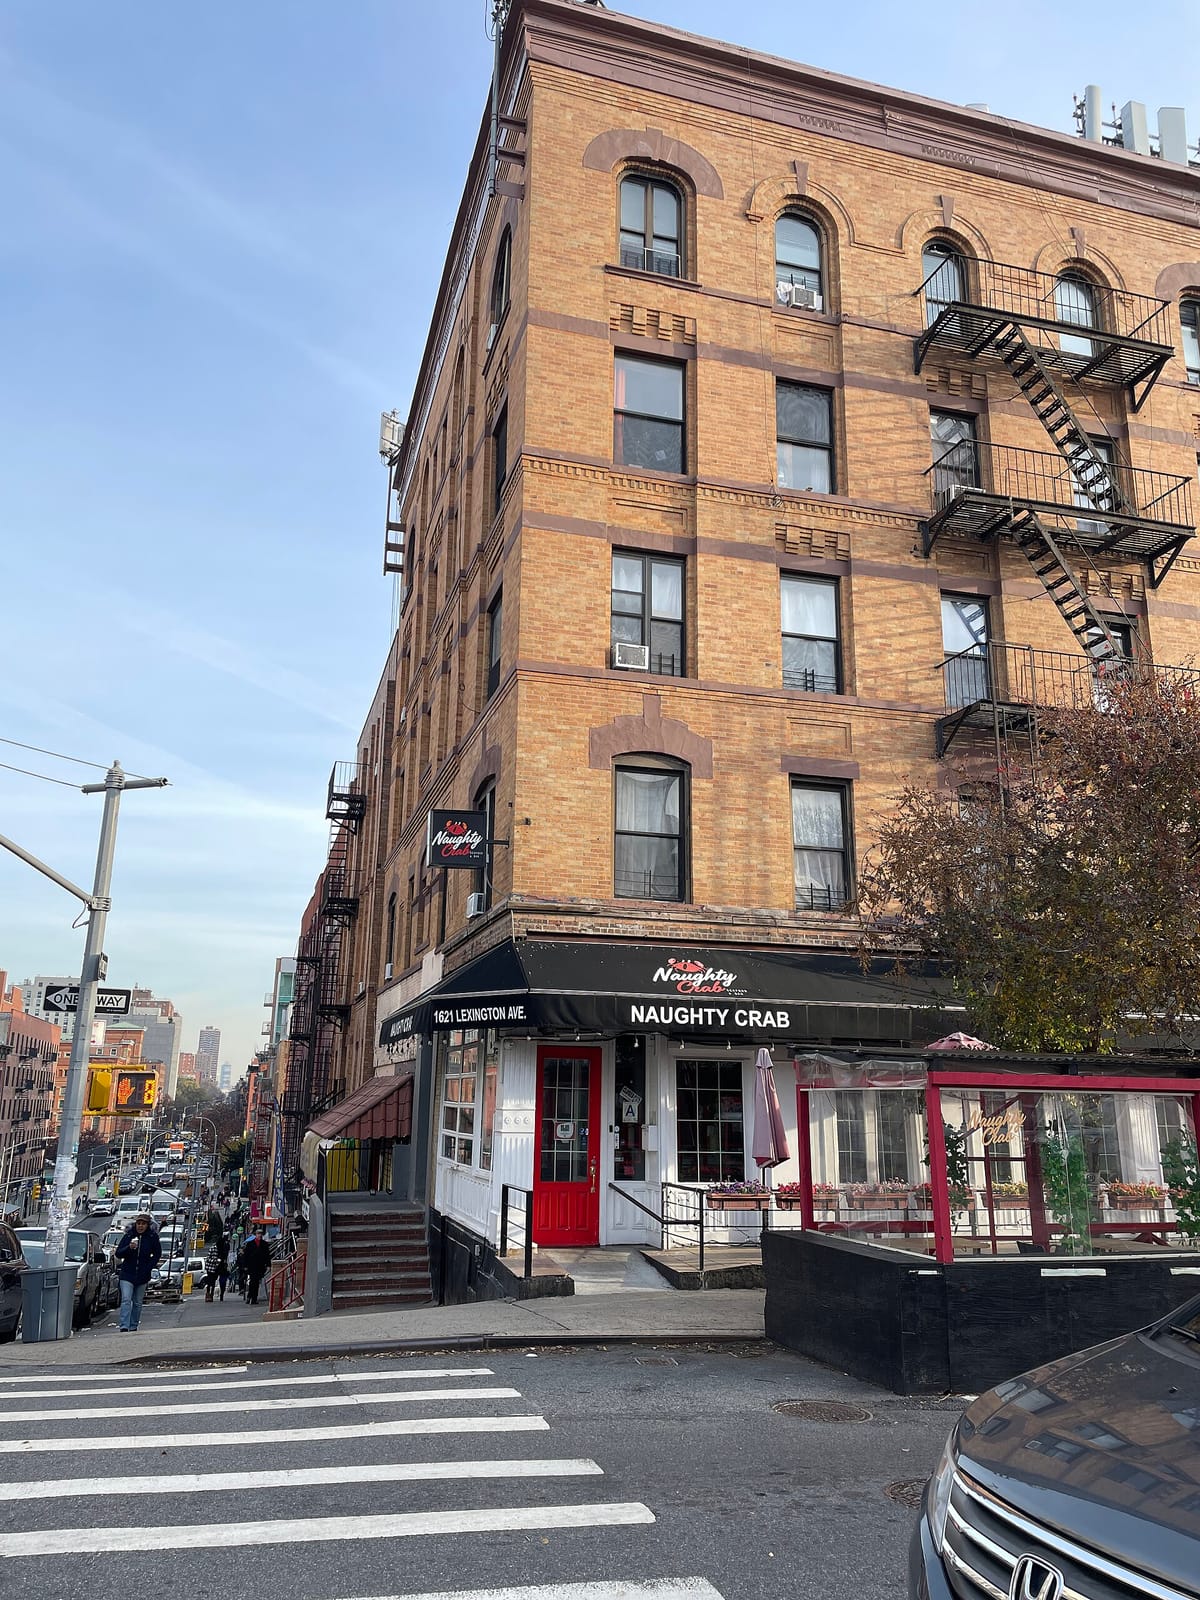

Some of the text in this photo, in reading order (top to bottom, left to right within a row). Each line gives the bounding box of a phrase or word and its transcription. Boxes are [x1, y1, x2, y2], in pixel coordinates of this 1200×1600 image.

[431, 829, 483, 850] Naughty
[441, 843, 471, 857] Crab
[652, 967, 737, 987] Naughty
[676, 980, 726, 994] Crab
[53, 993, 123, 1007] ONE WAY
[433, 1005, 527, 1024] 1621 LEXINGTON AVE.
[631, 1005, 790, 1028] NAUGHTY CRAB
[625, 1104, 636, 1117] A
[967, 1108, 1027, 1136] Naughty
[982, 1126, 1015, 1146] Crab
